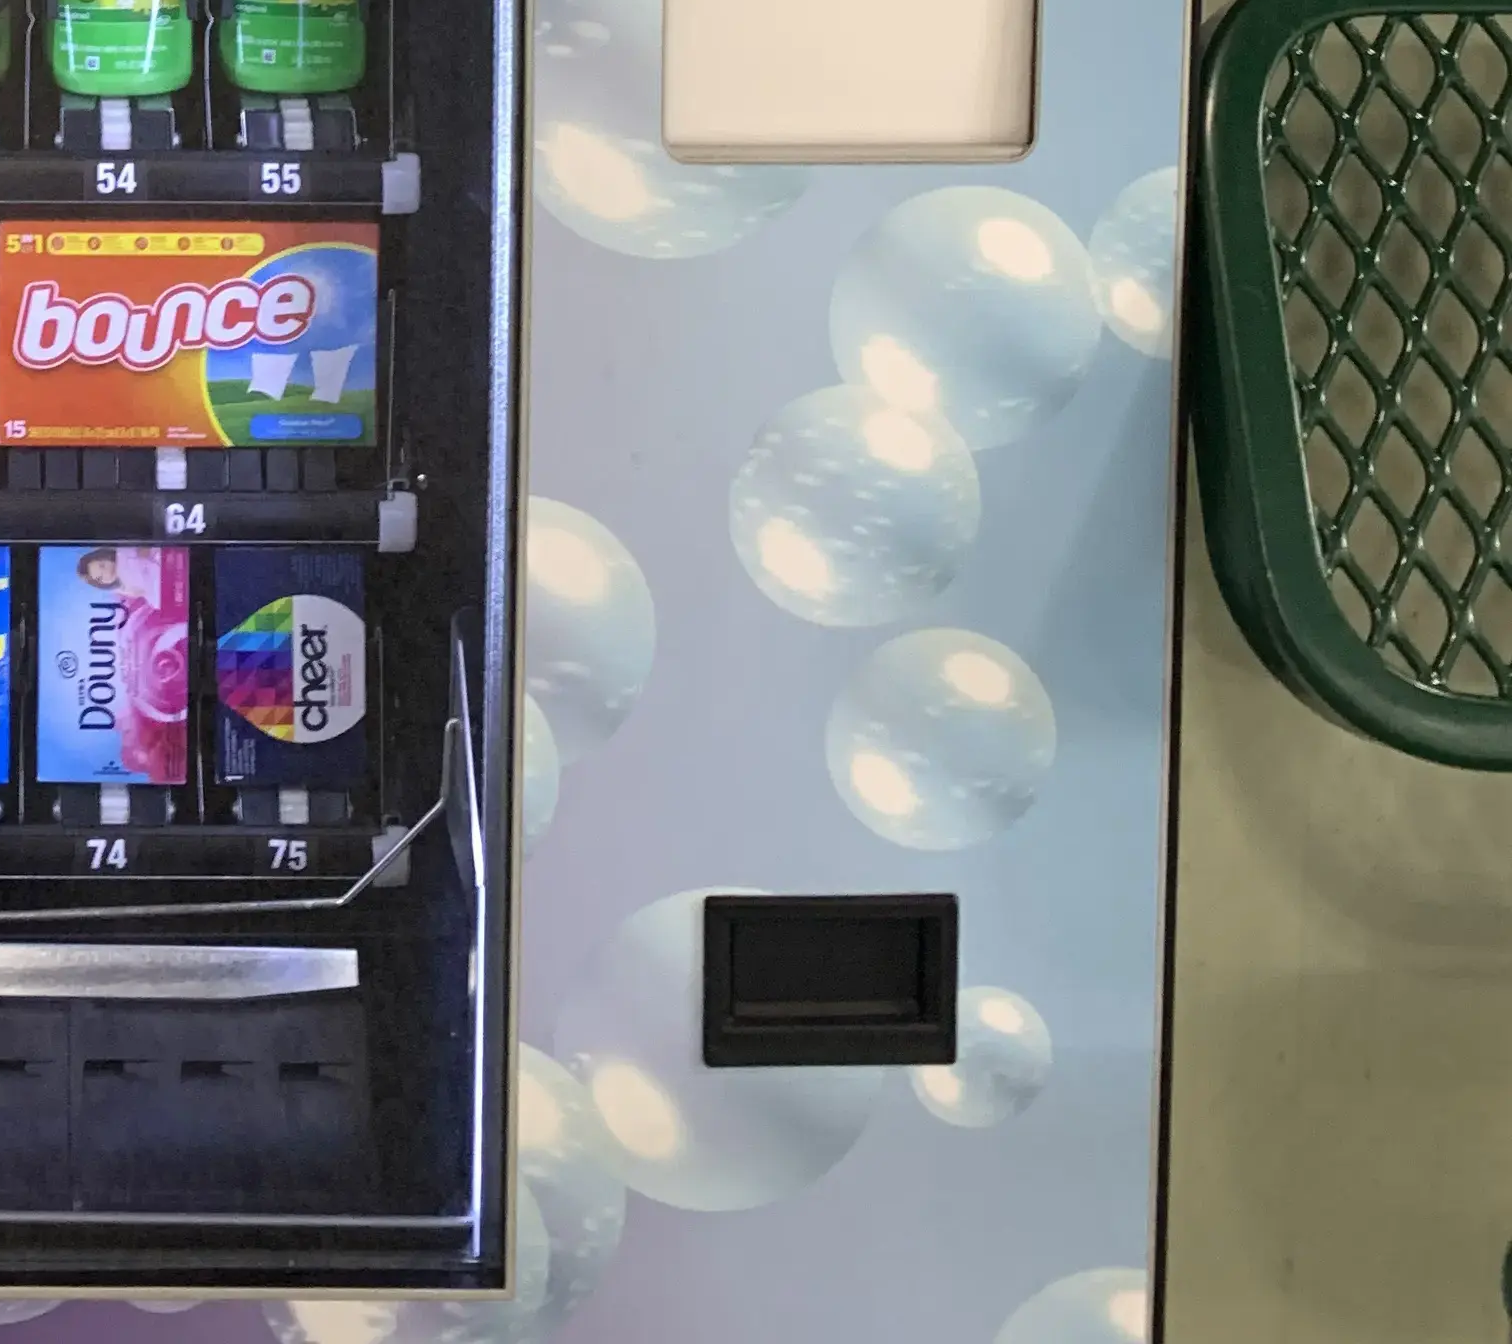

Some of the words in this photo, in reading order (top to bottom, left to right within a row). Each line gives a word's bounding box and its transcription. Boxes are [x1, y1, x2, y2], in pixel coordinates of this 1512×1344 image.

[97, 162, 137, 194] 54
[261, 162, 301, 194] 55
[21, 276, 311, 363] bounce
[4, 420, 27, 437] 15
[166, 503, 206, 533] 64
[78, 601, 130, 731] Downy
[293, 623, 329, 732] cheer
[87, 838, 127, 869] 74
[268, 839, 307, 870] 75
